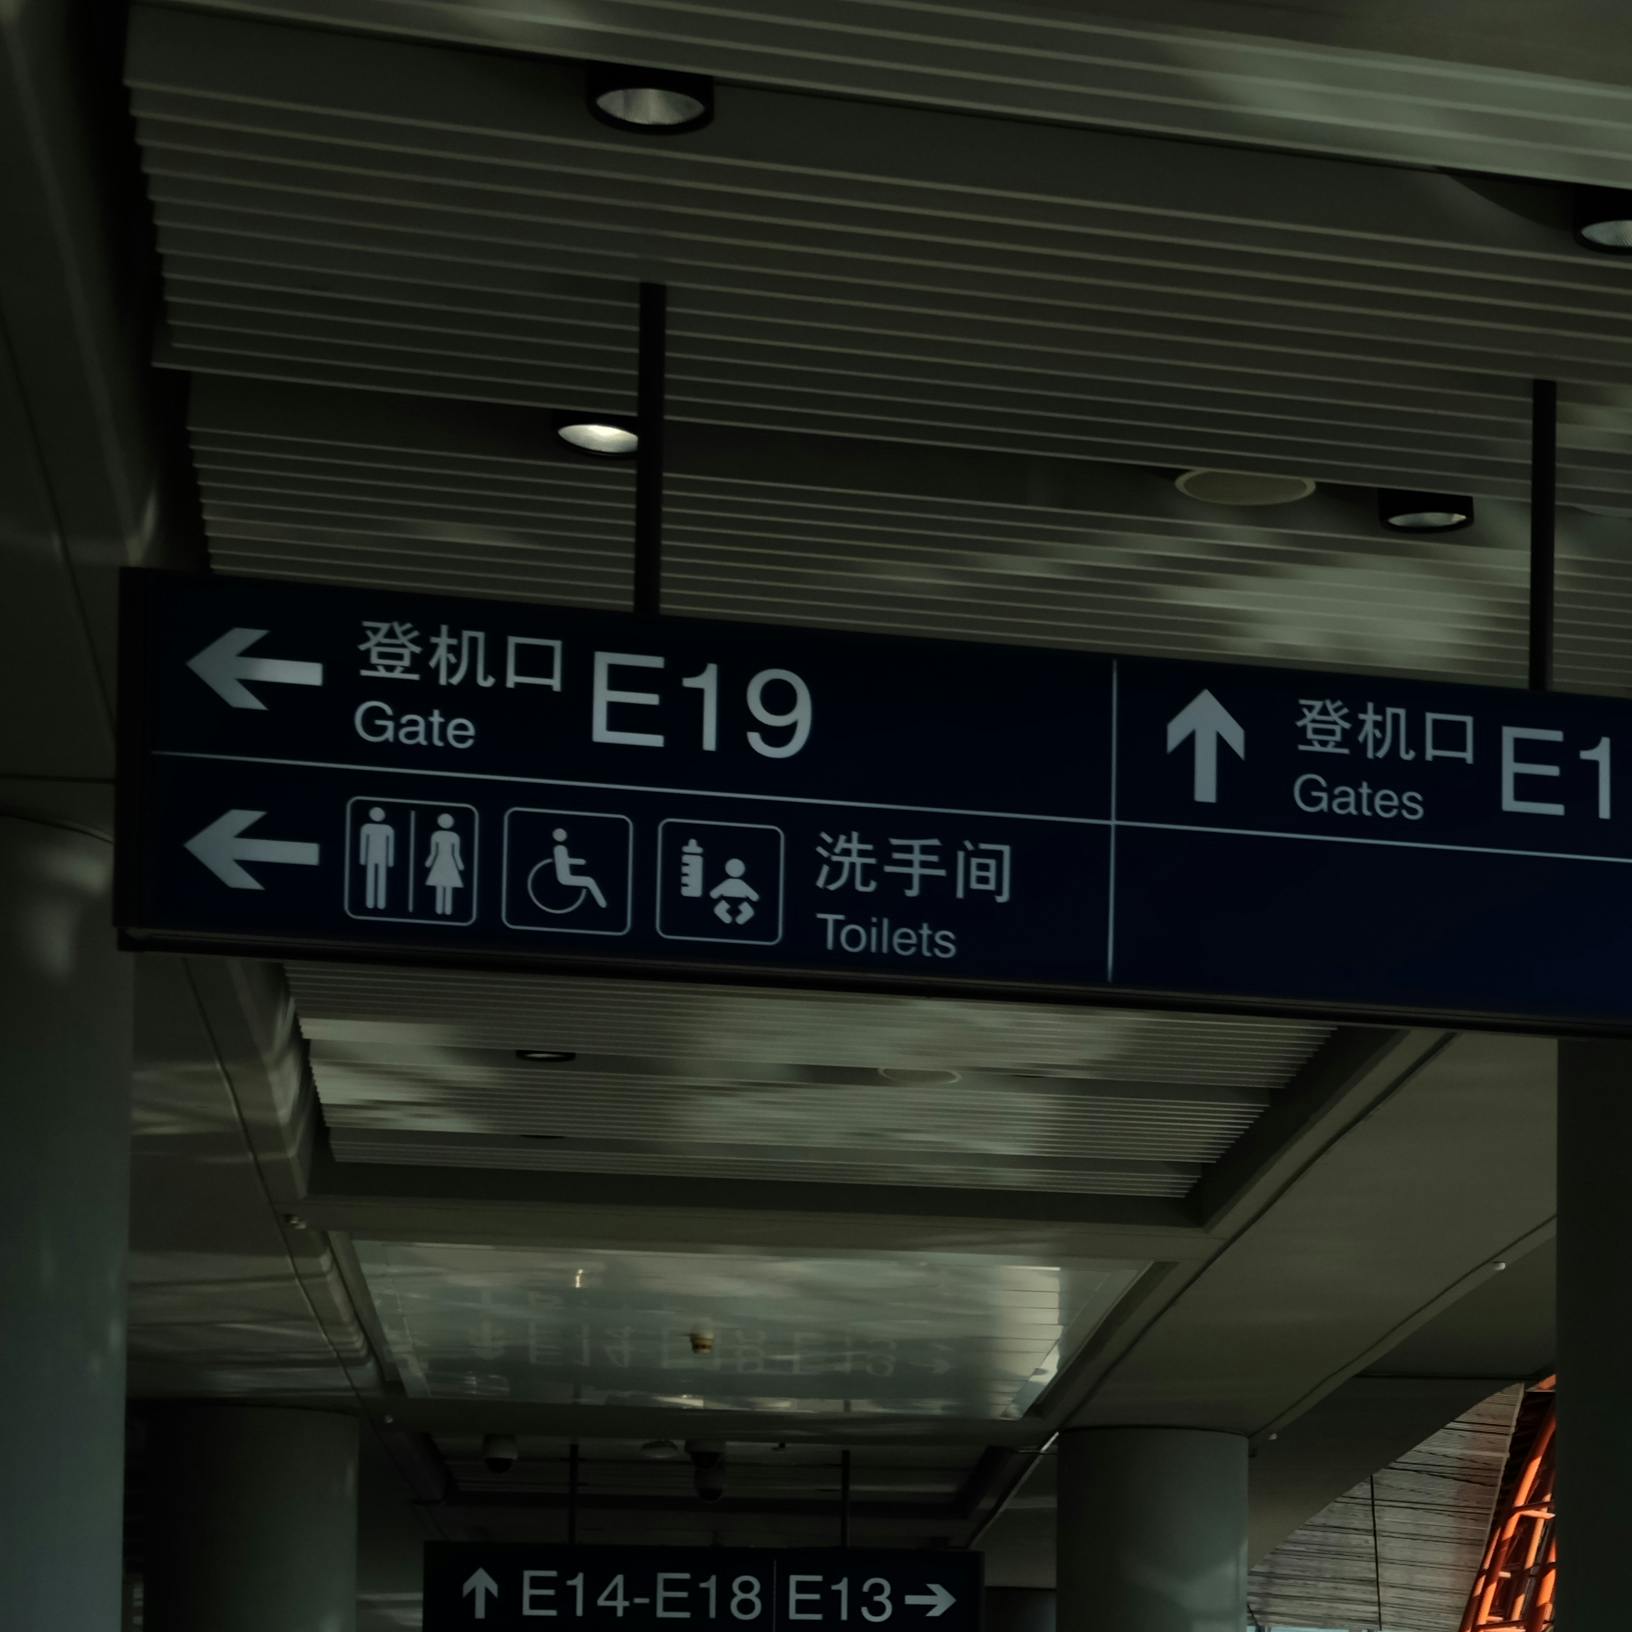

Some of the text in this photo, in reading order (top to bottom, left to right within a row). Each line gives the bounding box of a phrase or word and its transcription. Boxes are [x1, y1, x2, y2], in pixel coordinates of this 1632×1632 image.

[357, 620, 813, 759] 登机口 E19
[354, 700, 476, 749] Gate
[1295, 699, 1475, 765] 登机口
[1293, 773, 1424, 820] Gates
[815, 830, 1011, 903] 洗手间
[816, 912, 957, 959] Toilets
[522, 1569, 894, 1623] E14-E18 E13
